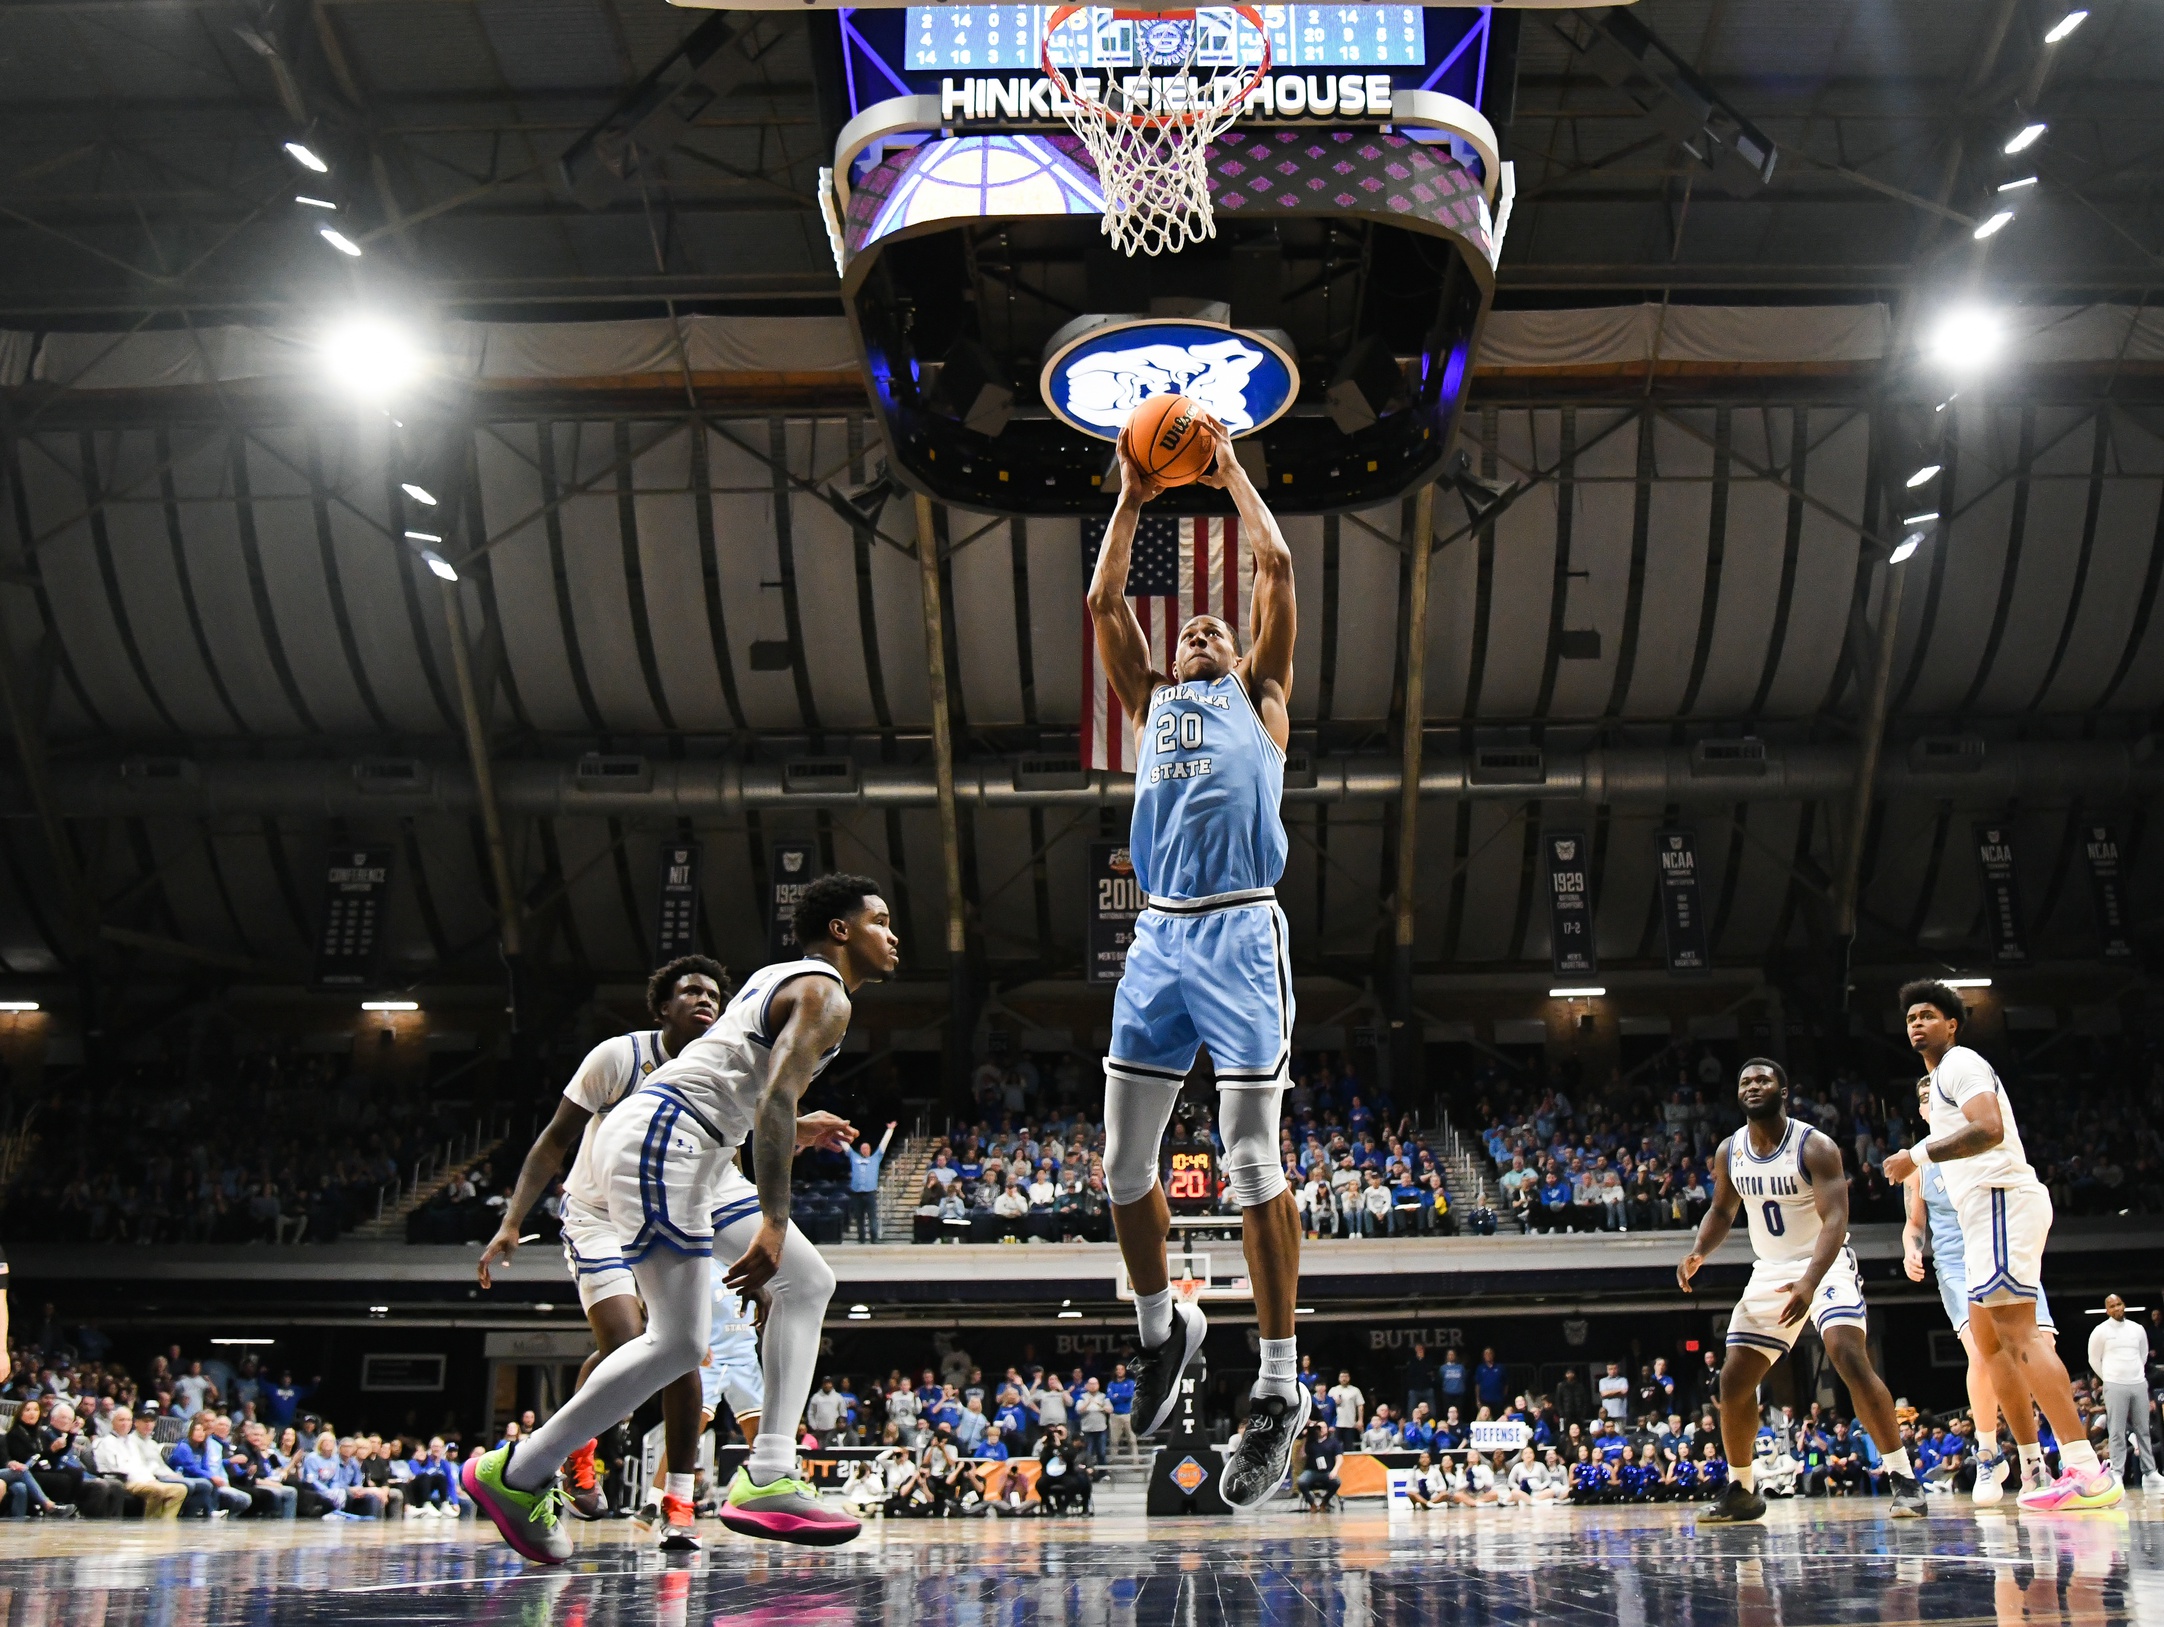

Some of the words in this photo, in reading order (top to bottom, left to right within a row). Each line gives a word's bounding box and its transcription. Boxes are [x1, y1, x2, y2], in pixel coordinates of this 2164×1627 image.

[921, 14, 933, 28] 2
[951, 14, 972, 28] 14
[988, 13, 999, 27] 0
[1016, 12, 1027, 27] 3
[1308, 9, 1319, 24] 2
[1338, 9, 1359, 24] 14
[1376, 9, 1385, 24] 1
[1403, 9, 1414, 24] 3
[920, 32, 933, 46] 4
[954, 31, 967, 46] 4
[988, 31, 999, 45] 0
[1304, 27, 1325, 42] 20
[1404, 27, 1415, 42] 3
[916, 50, 937, 64] 14
[988, 49, 999, 63] 3
[1016, 49, 1025, 63] 1
[1304, 46, 1324, 60] 21
[1405, 46, 1414, 60] 1
[942, 77, 1101, 119] HINKLE
[1123, 75, 1393, 118] FIELDHOUSE
[1159, 404, 1198, 450] Wilson
[1156, 711, 1203, 755] 20
[1150, 758, 1212, 784] STATE
[1981, 845, 2012, 863] NCAA
[2085, 842, 2118, 860] NCAA
[1662, 852, 1694, 869] NCAA
[669, 866, 690, 884] NIT
[1553, 872, 1584, 892] 1929
[1172, 1153, 1208, 1169] 10:49
[1170, 1171, 1204, 1197] 20
[1770, 1176, 1798, 1195] HALL
[1762, 1200, 1785, 1236] 0
[1370, 1328, 1464, 1350] BUTLER
[1181, 1379, 1195, 1434] NIT
[1476, 1428, 1520, 1442] DEFENSE
